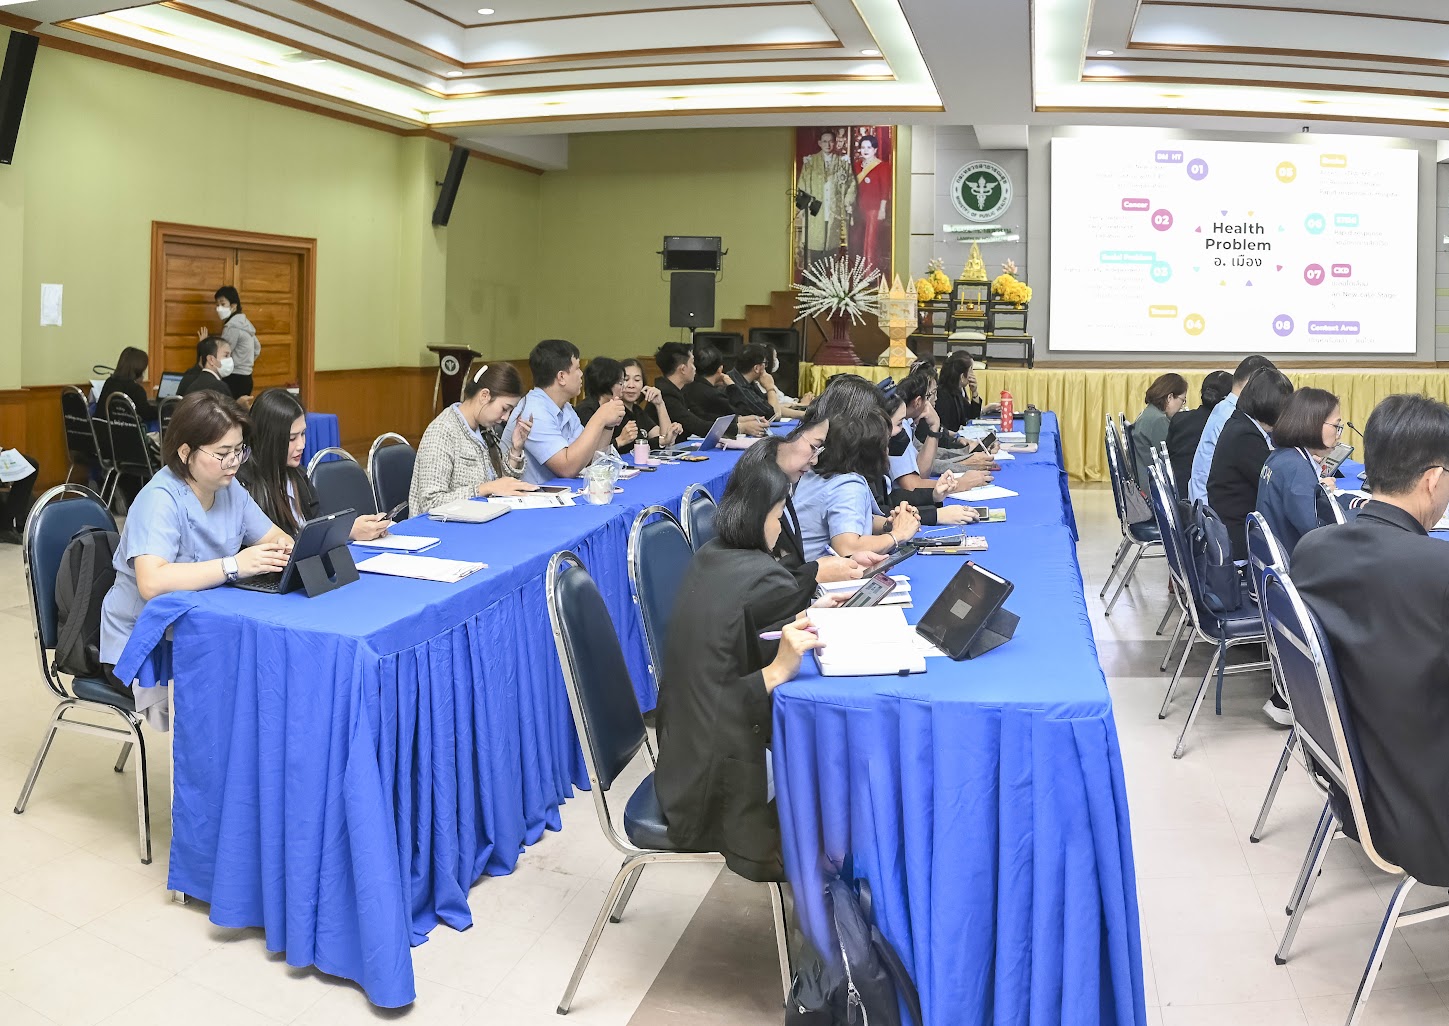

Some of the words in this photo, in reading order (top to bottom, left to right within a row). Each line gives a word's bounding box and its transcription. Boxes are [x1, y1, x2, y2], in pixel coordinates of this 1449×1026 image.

[1191, 165, 1204, 174] 01
[1279, 168, 1294, 177] 05
[955, 195, 970, 214] MINISTRY
[996, 197, 1007, 212] HEALTH
[1154, 215, 1170, 224] 02
[1307, 219, 1323, 228] 06
[1213, 222, 1265, 234] Health
[1205, 238, 1271, 251] Problem
[1214, 257, 1226, 267] อ.
[1232, 254, 1263, 267] เมือง
[1153, 267, 1168, 276] 03
[1306, 269, 1322, 279] 07
[1187, 320, 1203, 329] 04
[1275, 320, 1291, 330] 08
